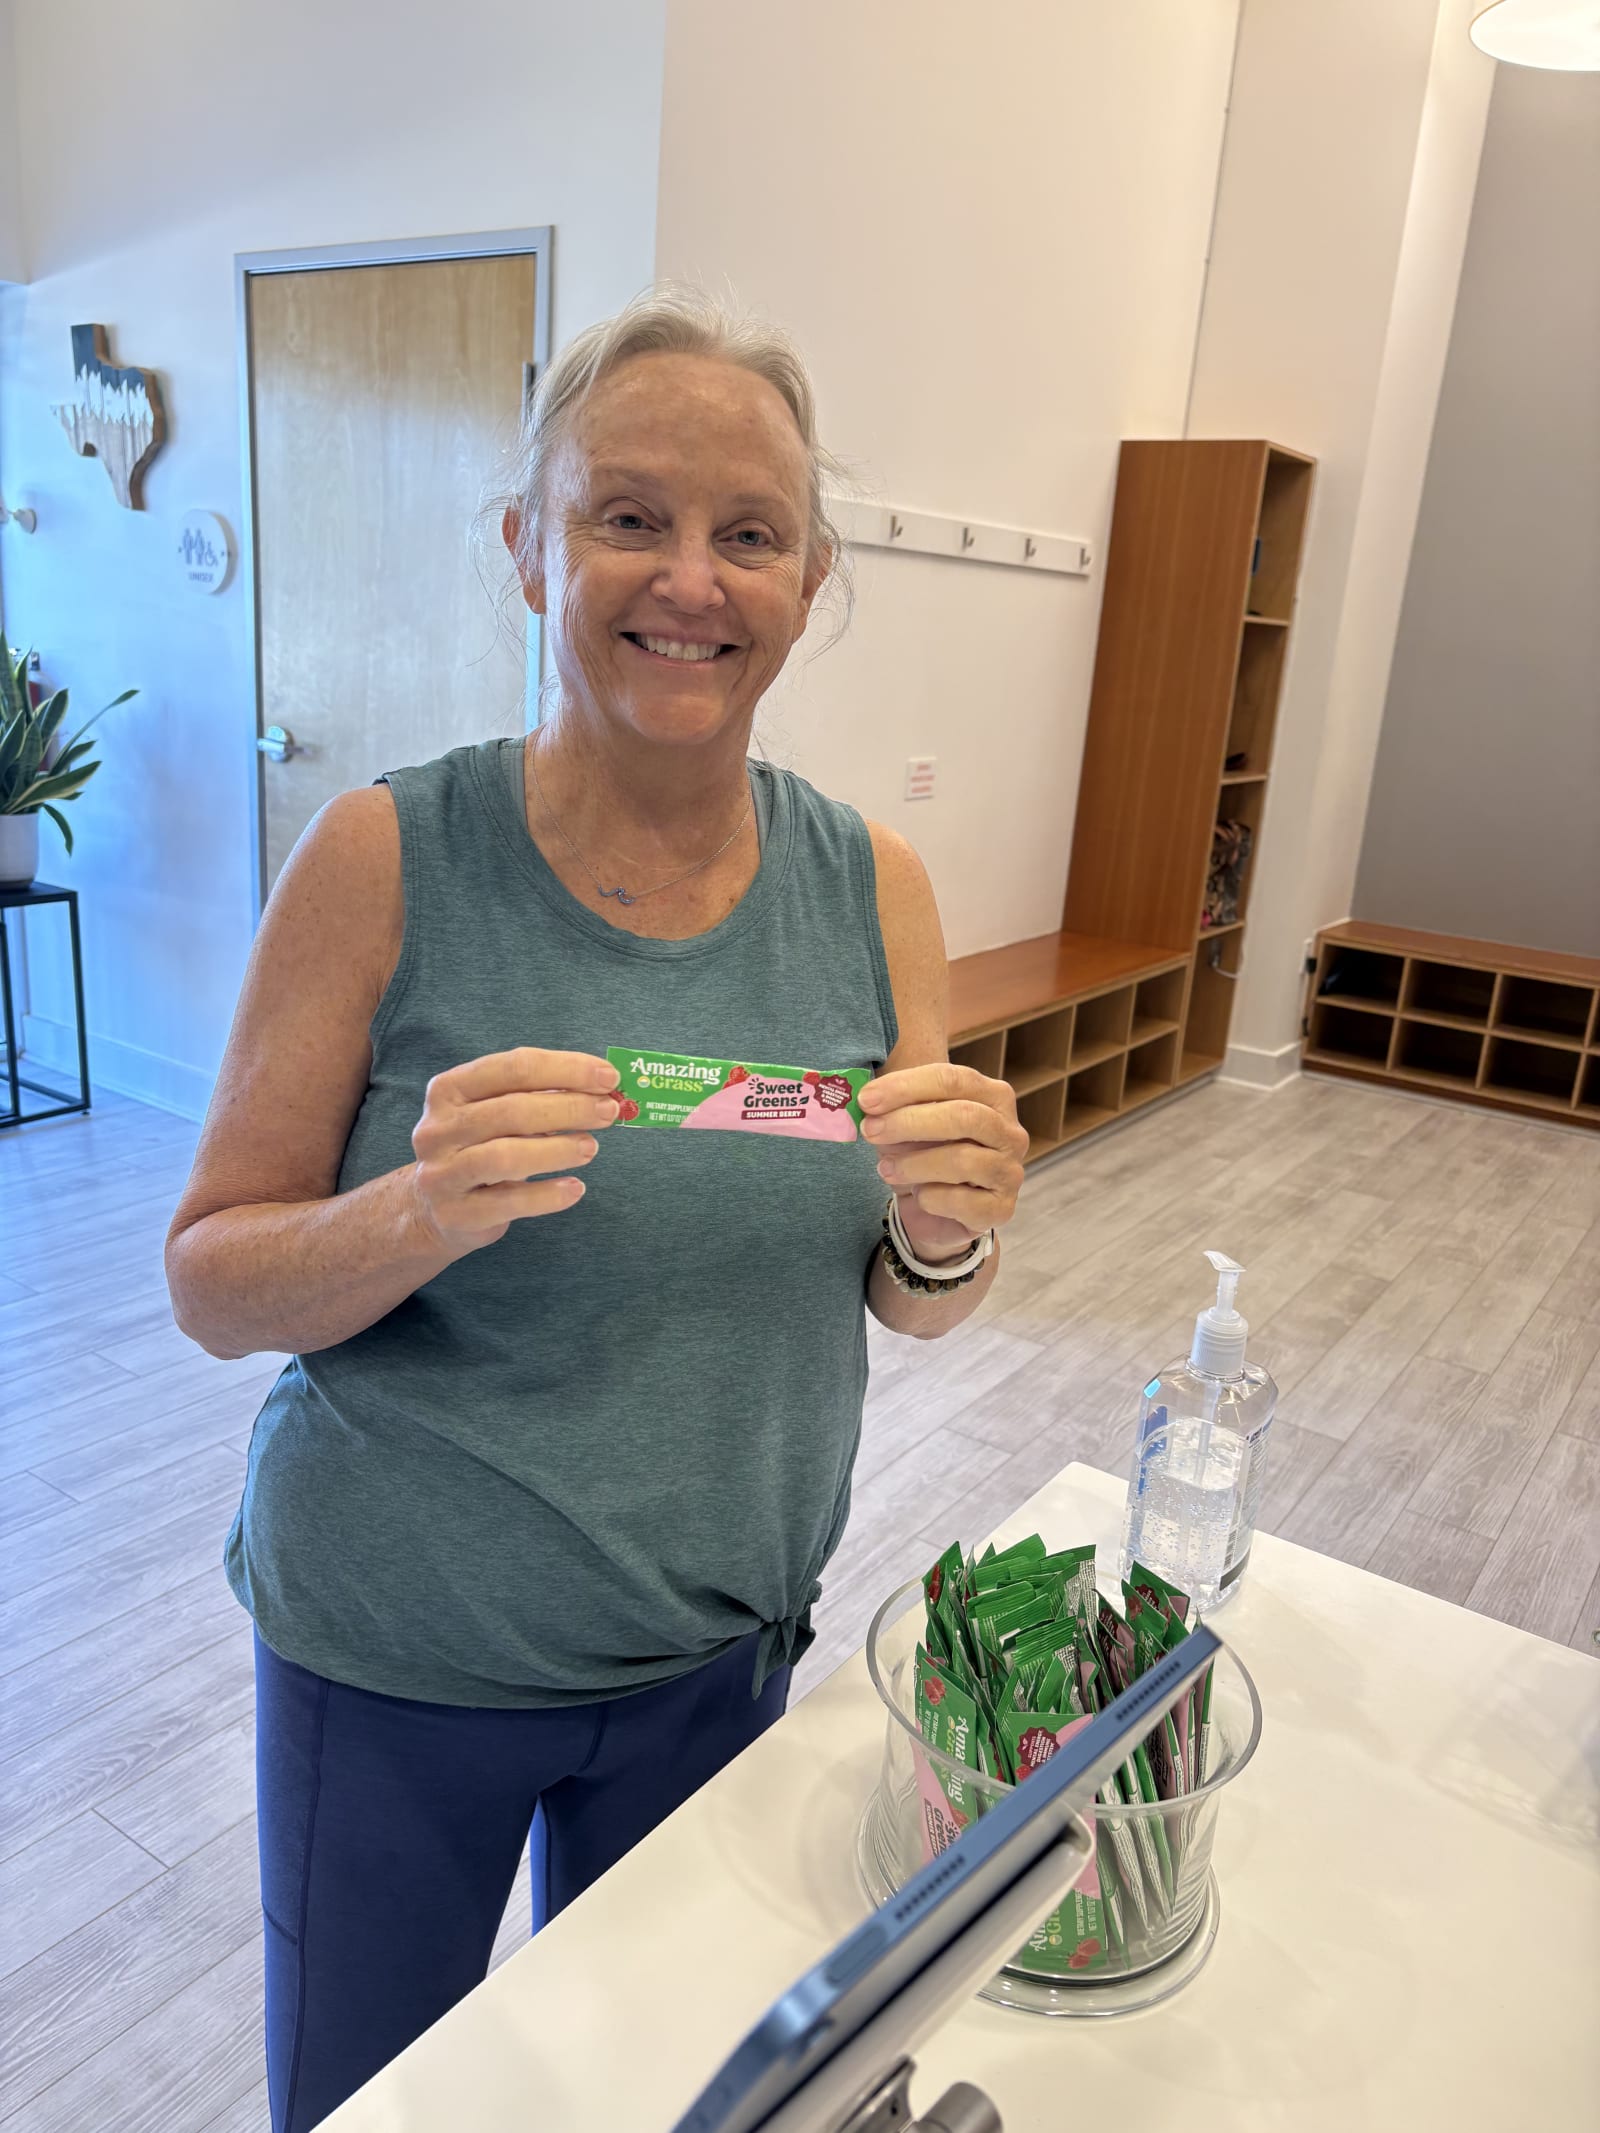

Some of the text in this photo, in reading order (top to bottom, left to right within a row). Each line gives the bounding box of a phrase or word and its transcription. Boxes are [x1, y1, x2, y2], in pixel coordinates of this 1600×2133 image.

[630, 1057, 722, 1085] Amazing
[651, 1075, 703, 1093] Grass
[755, 1081, 803, 1095] Sweet
[743, 1094, 798, 1108] Greens
[746, 1110, 802, 1119] SUMMER BERRY
[948, 1715, 969, 1805] Amaing
[934, 1807, 947, 1855] Green
